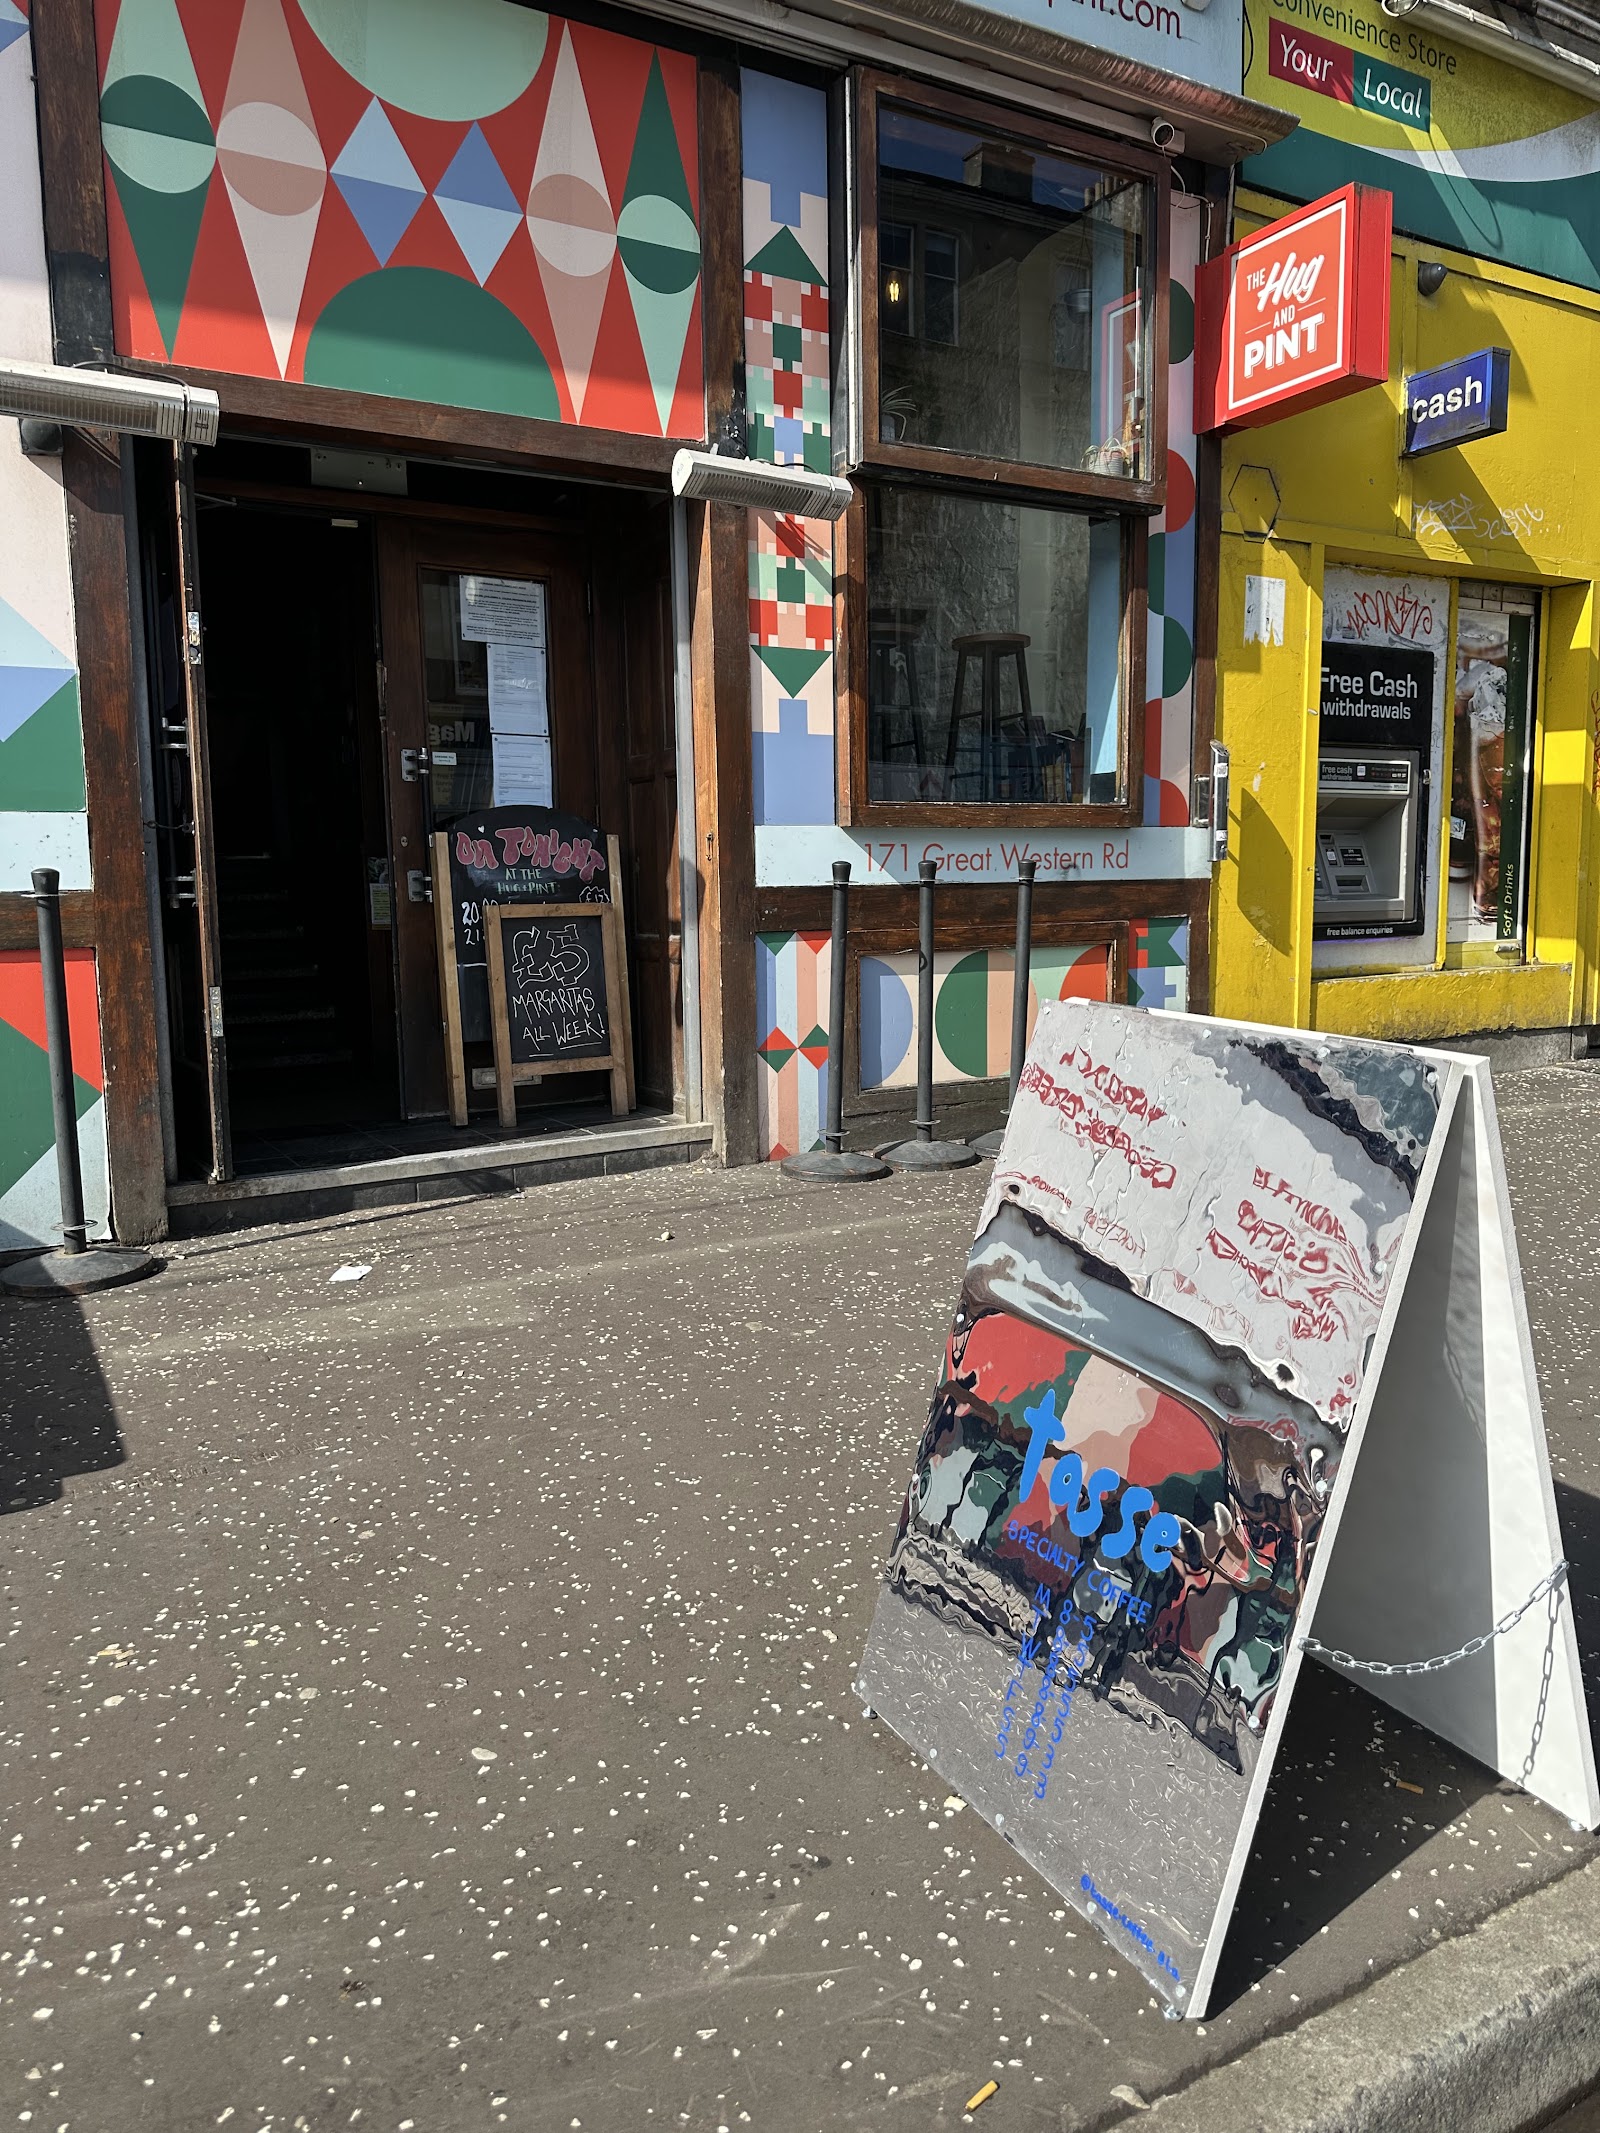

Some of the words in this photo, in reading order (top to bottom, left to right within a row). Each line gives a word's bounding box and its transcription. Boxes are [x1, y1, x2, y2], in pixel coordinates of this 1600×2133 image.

[1408, 33, 1458, 75] Store
[1280, 34, 1334, 82] Your
[1363, 68, 1424, 119] Local
[1246, 267, 1266, 292] THE
[1256, 252, 1325, 312] Hug
[1272, 304, 1296, 330] AND
[1243, 312, 1325, 379] PINT
[1411, 376, 1484, 424] cash
[1369, 670, 1418, 699] Cash
[1322, 698, 1412, 720] withdrawals
[1321, 764, 1336, 774] free
[1336, 766, 1353, 775] cash
[864, 843, 908, 871] 171
[922, 843, 992, 871] Great
[1000, 843, 1093, 870] Western
[1103, 839, 1129, 868] Rd
[505, 868, 517, 880] AT
[520, 868, 543, 880] THE
[1503, 863, 1515, 905] Drinks
[1326, 928, 1340, 936] free
[1341, 928, 1365, 936] balance
[1365, 926, 1394, 936] enquiries
[1502, 909, 1514, 937] Soft
[512, 924, 590, 989] £5
[512, 987, 595, 1024] MARGARITAS
[522, 1026, 551, 1051] ALL
[1019, 1388, 1181, 1573] tasse
[1008, 1520, 1085, 1578] SPECIALTY
[1087, 1570, 1152, 1623] COFFEE
[1034, 1583, 1050, 1611] M
[1031, 1604, 1048, 1630] T
[1007, 1679, 1024, 1701] F
